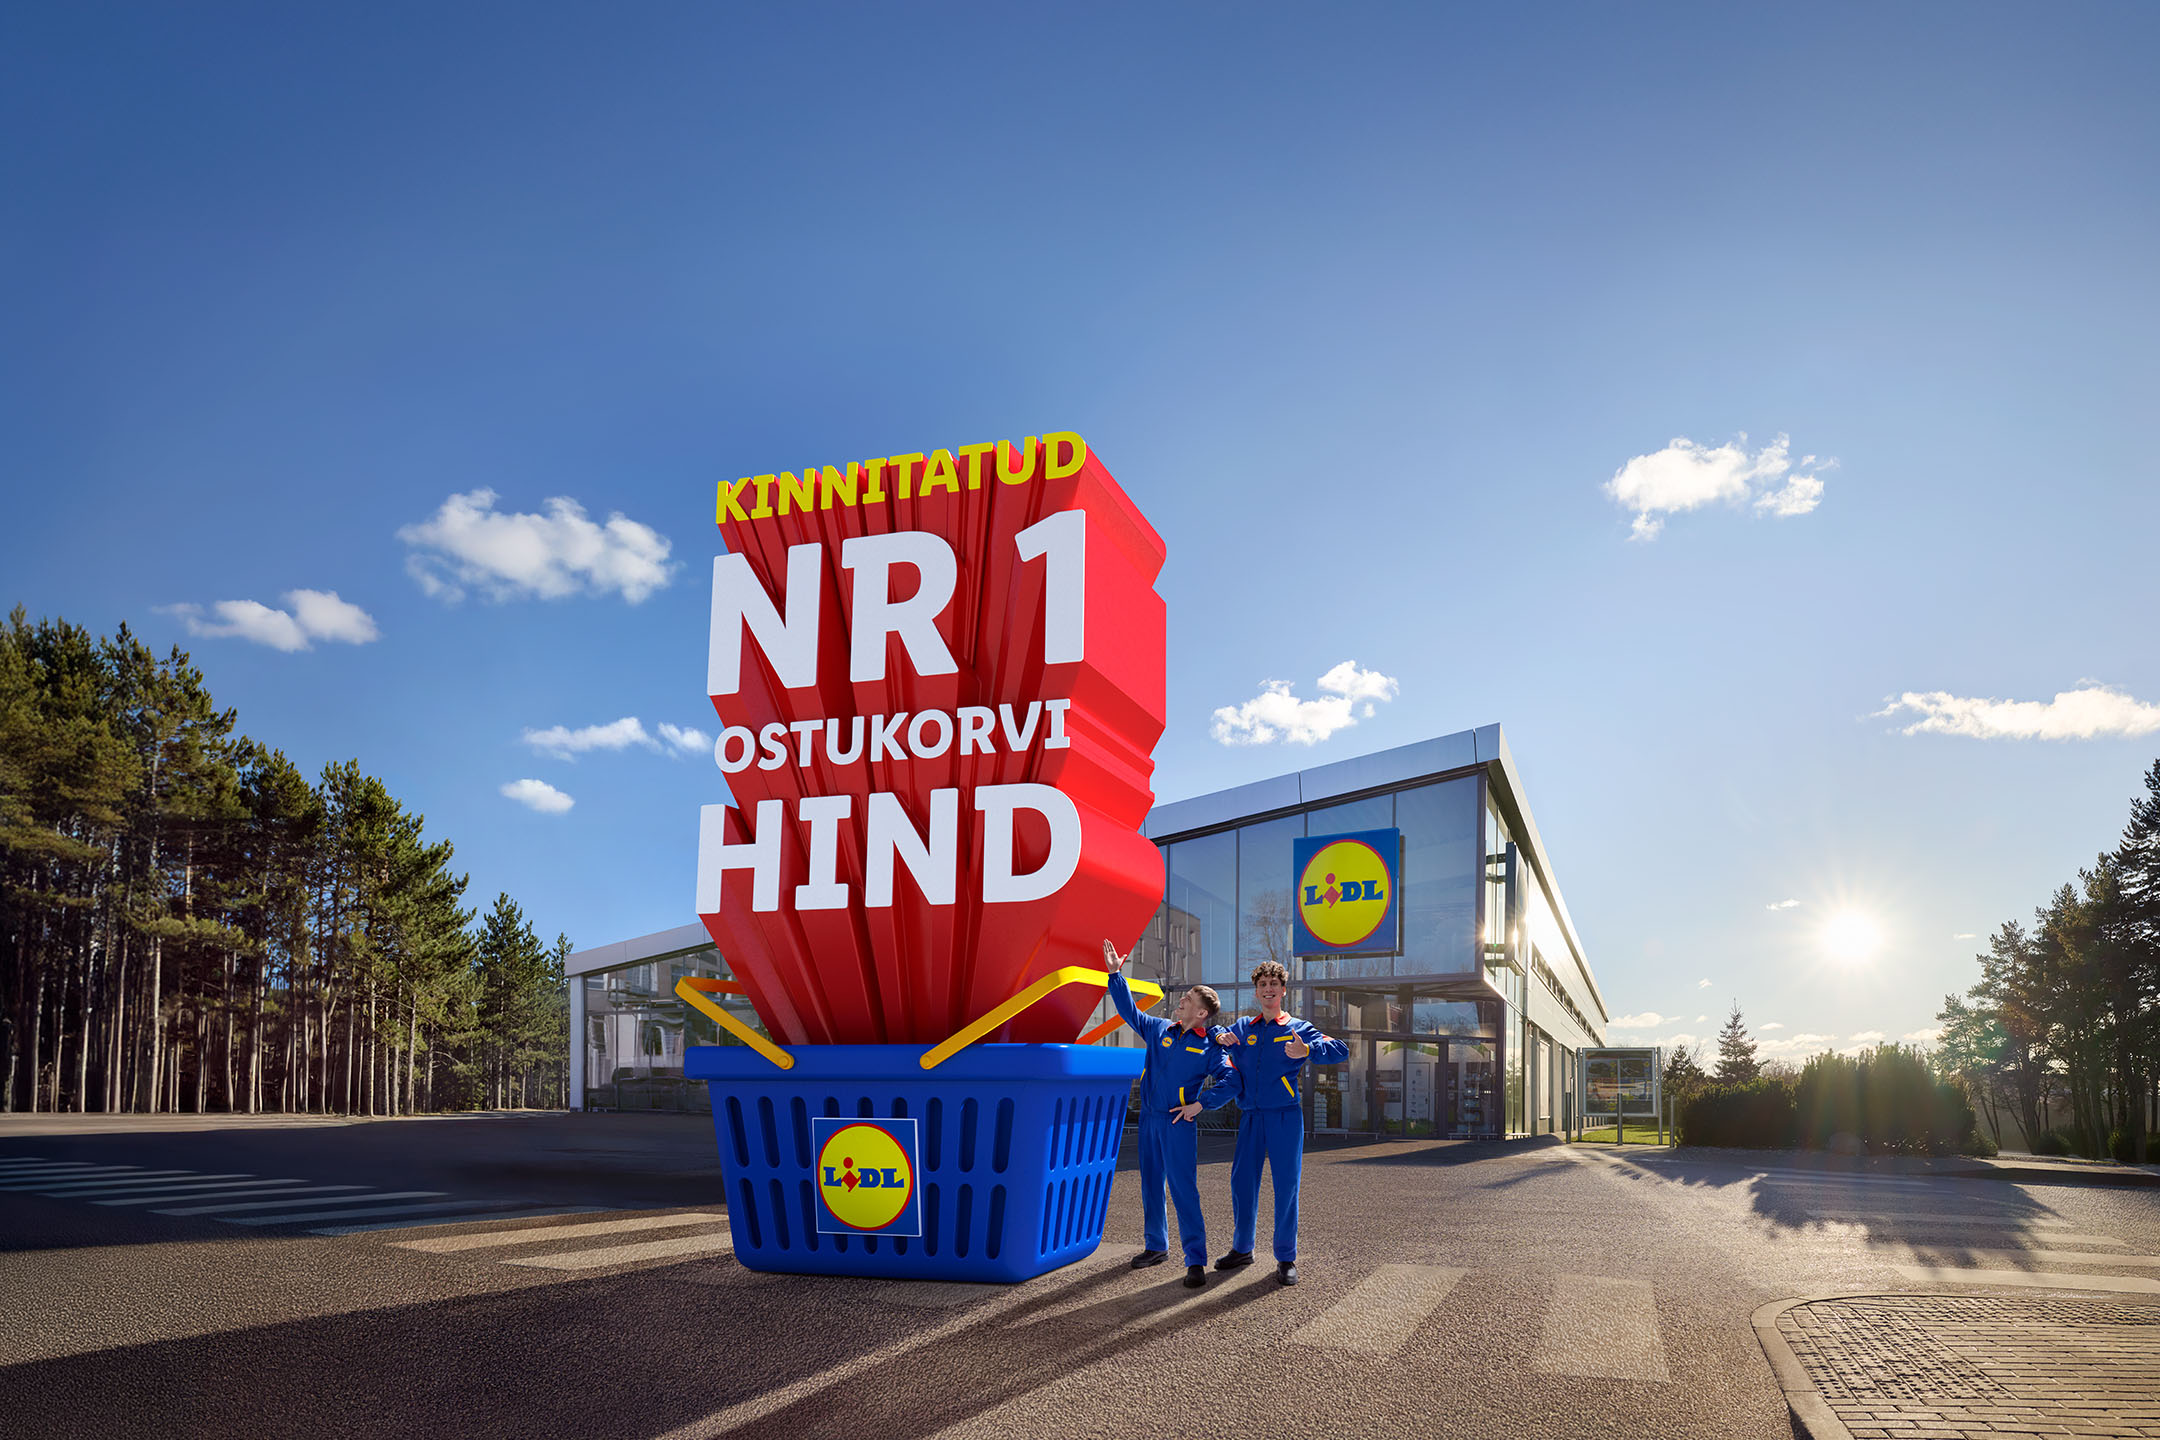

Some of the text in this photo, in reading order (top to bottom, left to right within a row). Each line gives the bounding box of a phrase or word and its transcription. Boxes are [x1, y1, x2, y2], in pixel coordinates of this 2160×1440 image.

[715, 430, 1087, 525] KINNITATUD
[707, 508, 1086, 696] NR 1
[714, 698, 1071, 774] OSTUKORVI
[695, 782, 1082, 915] HIND
